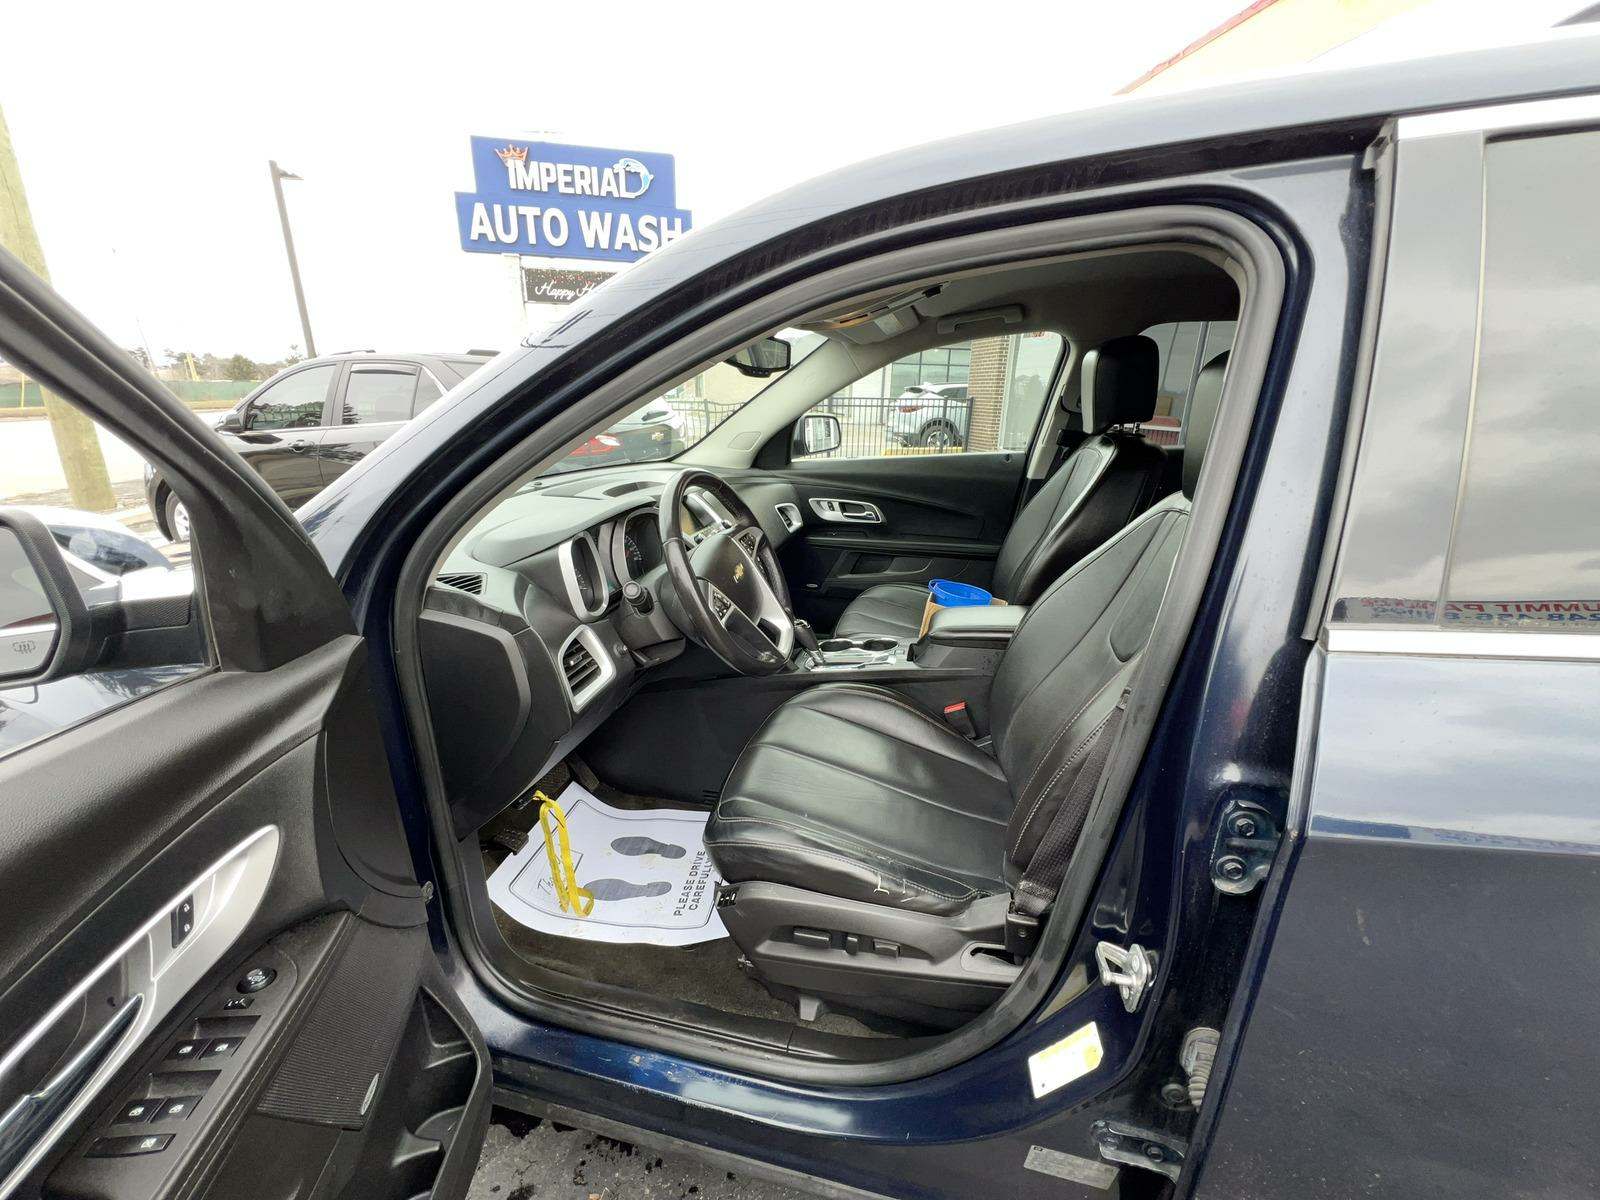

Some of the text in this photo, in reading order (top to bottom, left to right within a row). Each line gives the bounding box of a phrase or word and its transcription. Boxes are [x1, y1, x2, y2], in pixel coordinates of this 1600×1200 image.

[507, 158, 642, 199] IMPERIAL
[470, 202, 683, 252] AUTO WASH
[535, 278, 576, 300] Happy
[673, 850, 706, 916] PLEASE DRIVE
